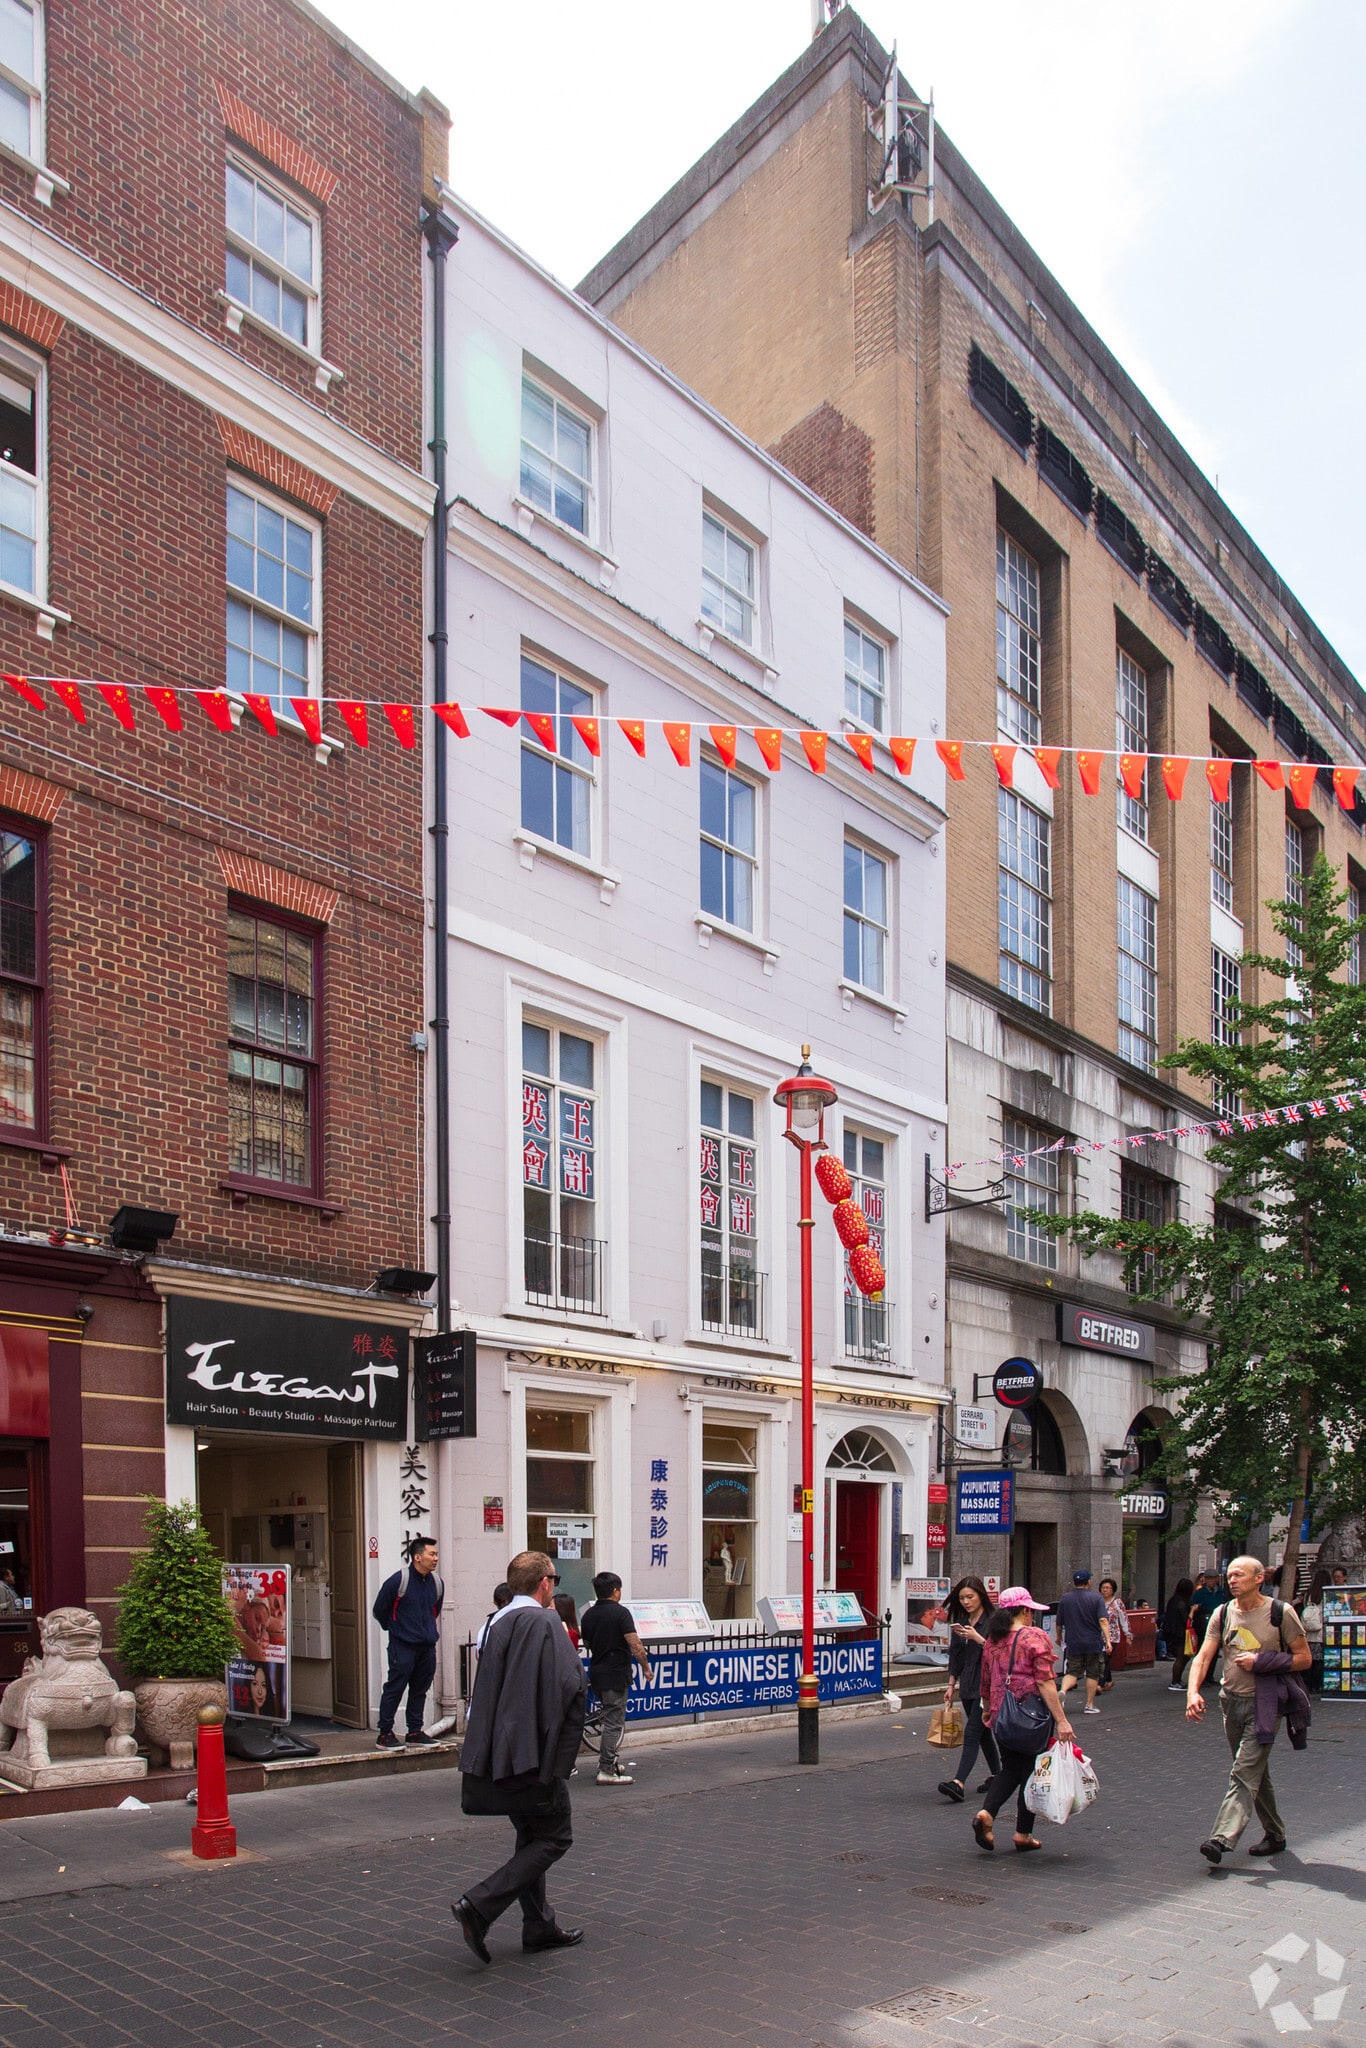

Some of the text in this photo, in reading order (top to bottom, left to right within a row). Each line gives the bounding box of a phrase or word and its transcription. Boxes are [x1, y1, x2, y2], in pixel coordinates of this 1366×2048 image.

[1081, 1318, 1139, 1349] BETFRED
[352, 1333, 398, 1359] 雅姿
[507, 1351, 620, 1374] EVERWEL
[704, 1376, 778, 1395] CHINESE
[997, 1376, 1034, 1387] BETFRED
[441, 1391, 459, 1399] Beauty
[837, 1393, 913, 1411] MEDICINE
[186, 1402, 397, 1429] Hair Salon Beauty Studio Massage Parlour
[960, 1419, 987, 1430] STREET W1
[961, 1410, 983, 1420] GERRARD
[961, 1481, 1000, 1494] ACUPUNCTURE
[650, 1459, 668, 1567] 康泰診所
[961, 1498, 1000, 1509] MASSAGE
[1120, 1495, 1165, 1514] ETFRED
[907, 1579, 936, 1591] Massage
[705, 1653, 788, 1686] CHINESE
[683, 1689, 743, 1708] MASSAGE
[754, 1684, 792, 1700] HERBS
